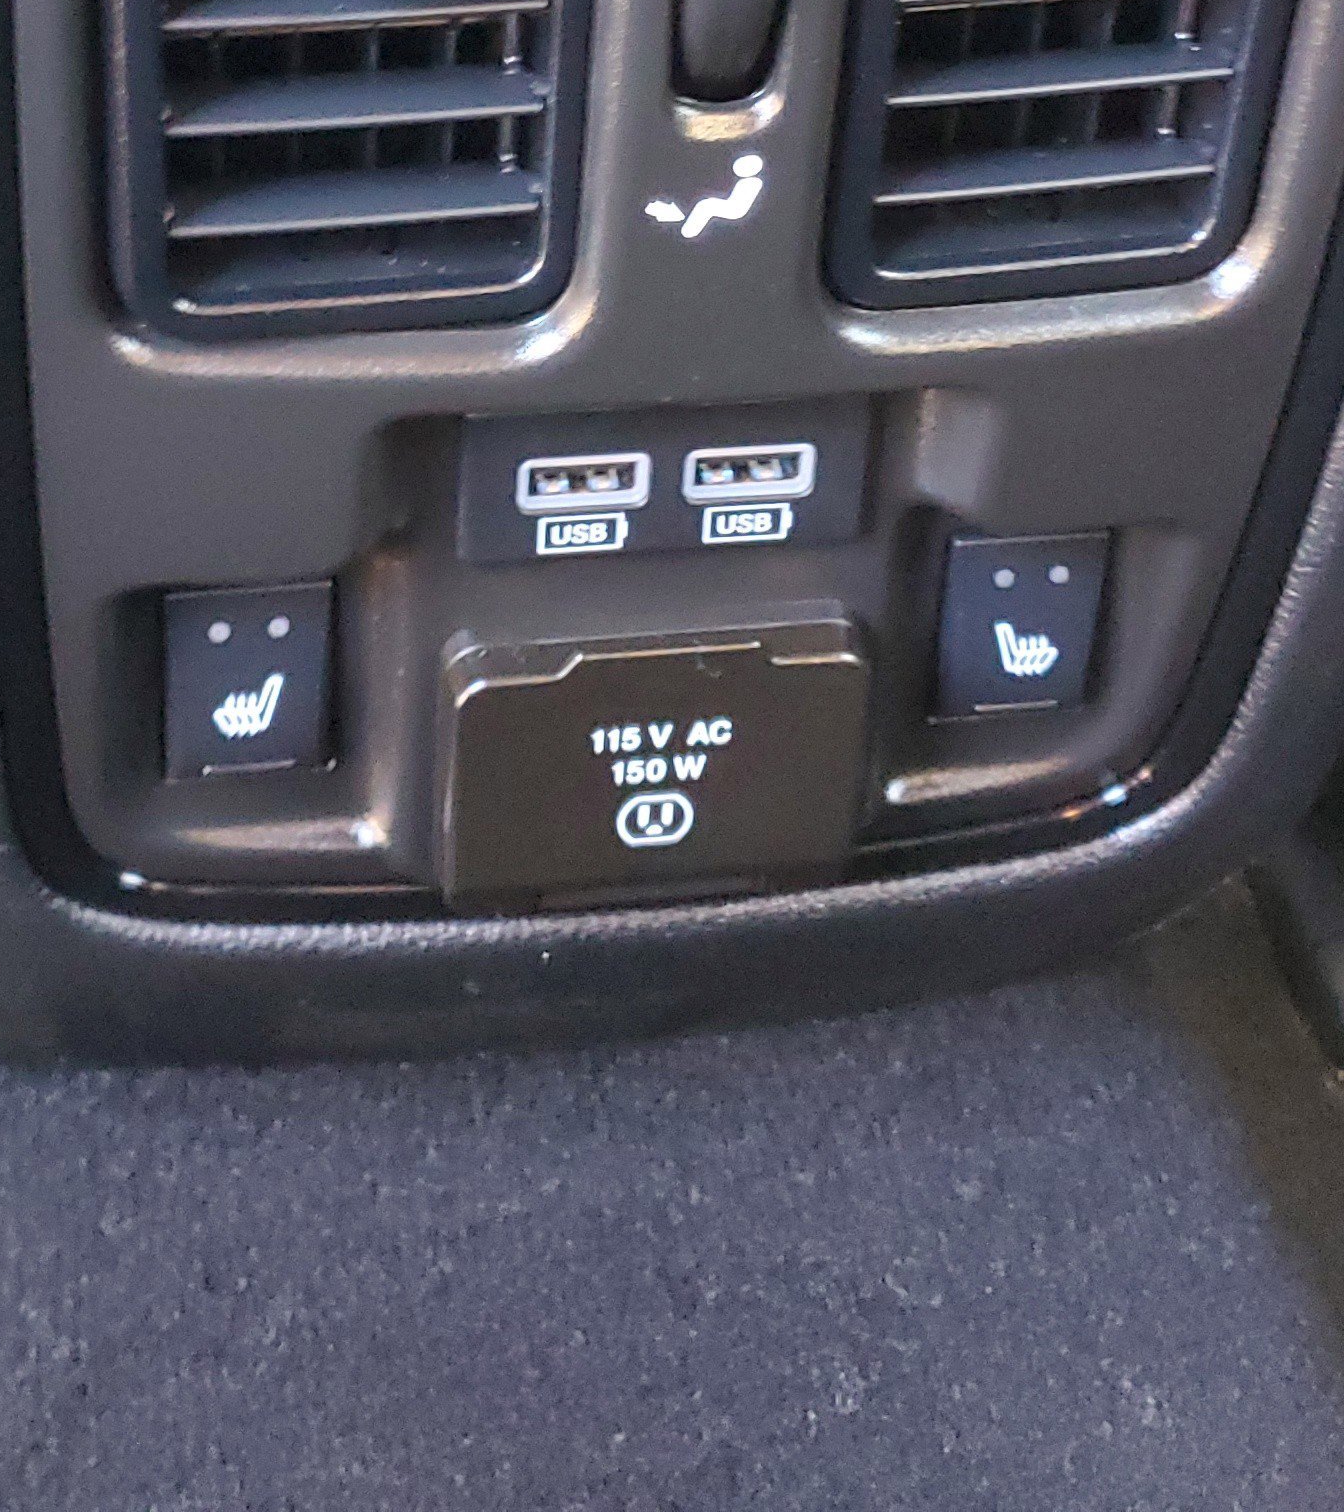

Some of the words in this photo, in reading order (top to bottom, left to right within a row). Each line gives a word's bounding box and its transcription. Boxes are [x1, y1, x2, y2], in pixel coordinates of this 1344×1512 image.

[549, 522, 608, 545] USB
[715, 512, 773, 535] USB
[590, 725, 642, 755] 115
[647, 722, 674, 749] V
[686, 719, 733, 746] AC
[611, 758, 668, 786] 150
[673, 754, 707, 781] W
